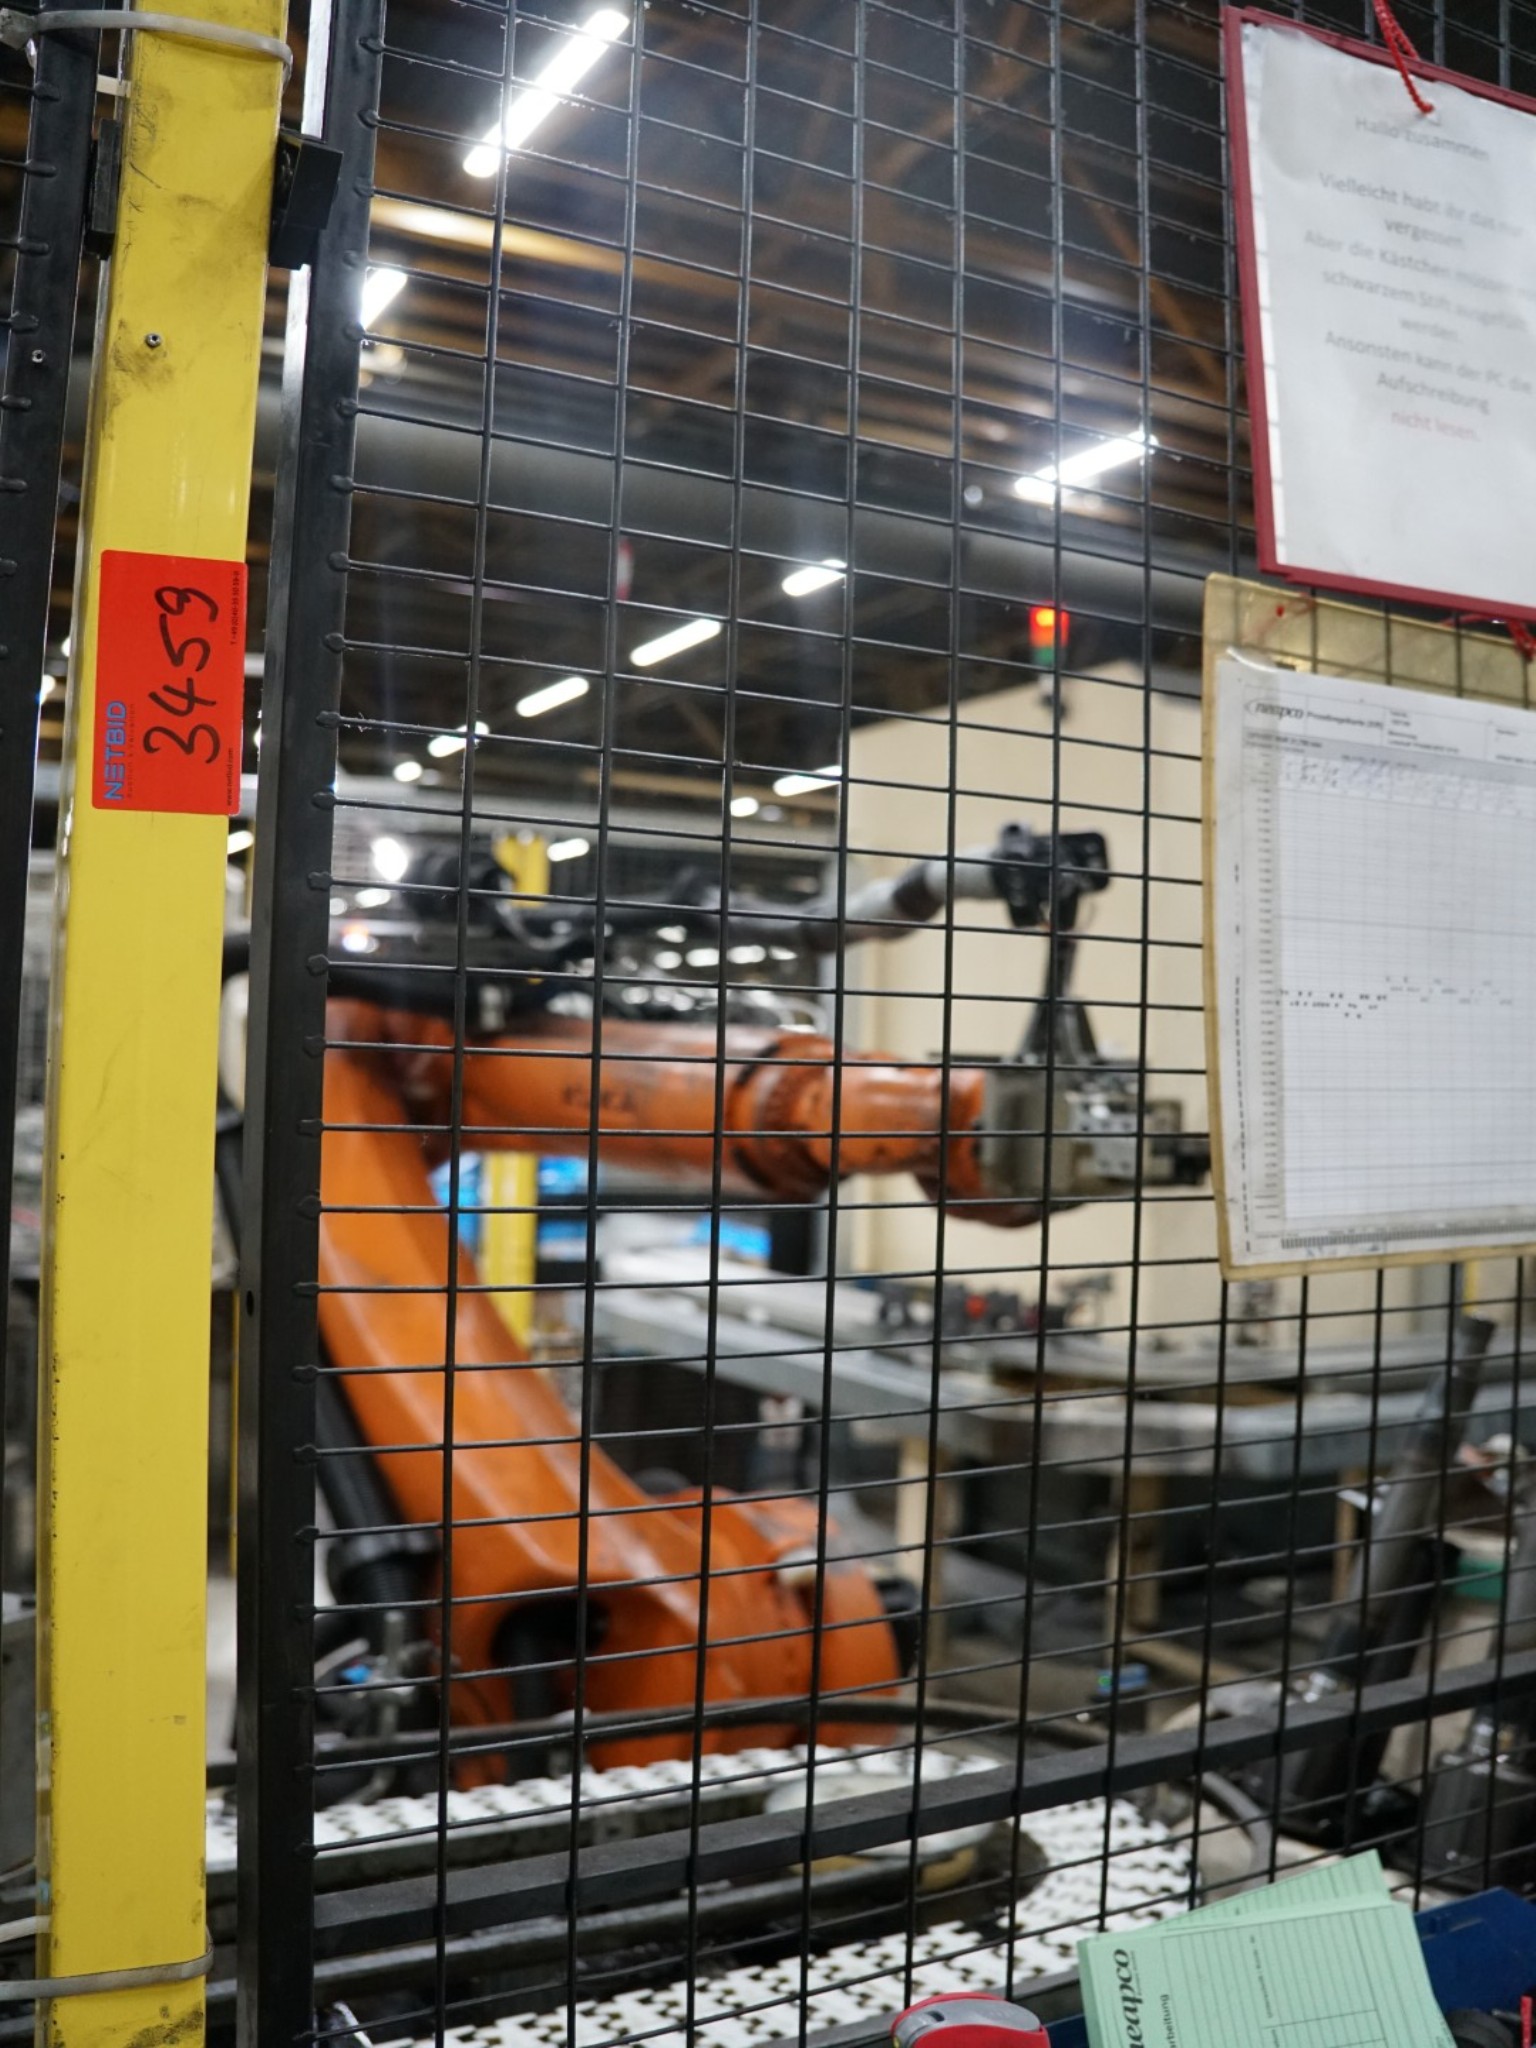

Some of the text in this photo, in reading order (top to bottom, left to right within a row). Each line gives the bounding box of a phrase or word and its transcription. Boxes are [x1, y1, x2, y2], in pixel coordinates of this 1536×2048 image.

[1319, 171, 1398, 205] Vielleicht
[1304, 229, 1344, 252] Aber
[1379, 248, 1450, 279] Kästchen
[1322, 270, 1417, 304] schwarzem
[1324, 330, 1413, 364] Ansonsten
[1415, 354, 1453, 374] kann
[1376, 371, 1491, 416] Aufschreibung
[1391, 411, 1432, 432] nicht
[143, 586, 220, 764] 3459
[104, 700, 128, 801] NETBID
